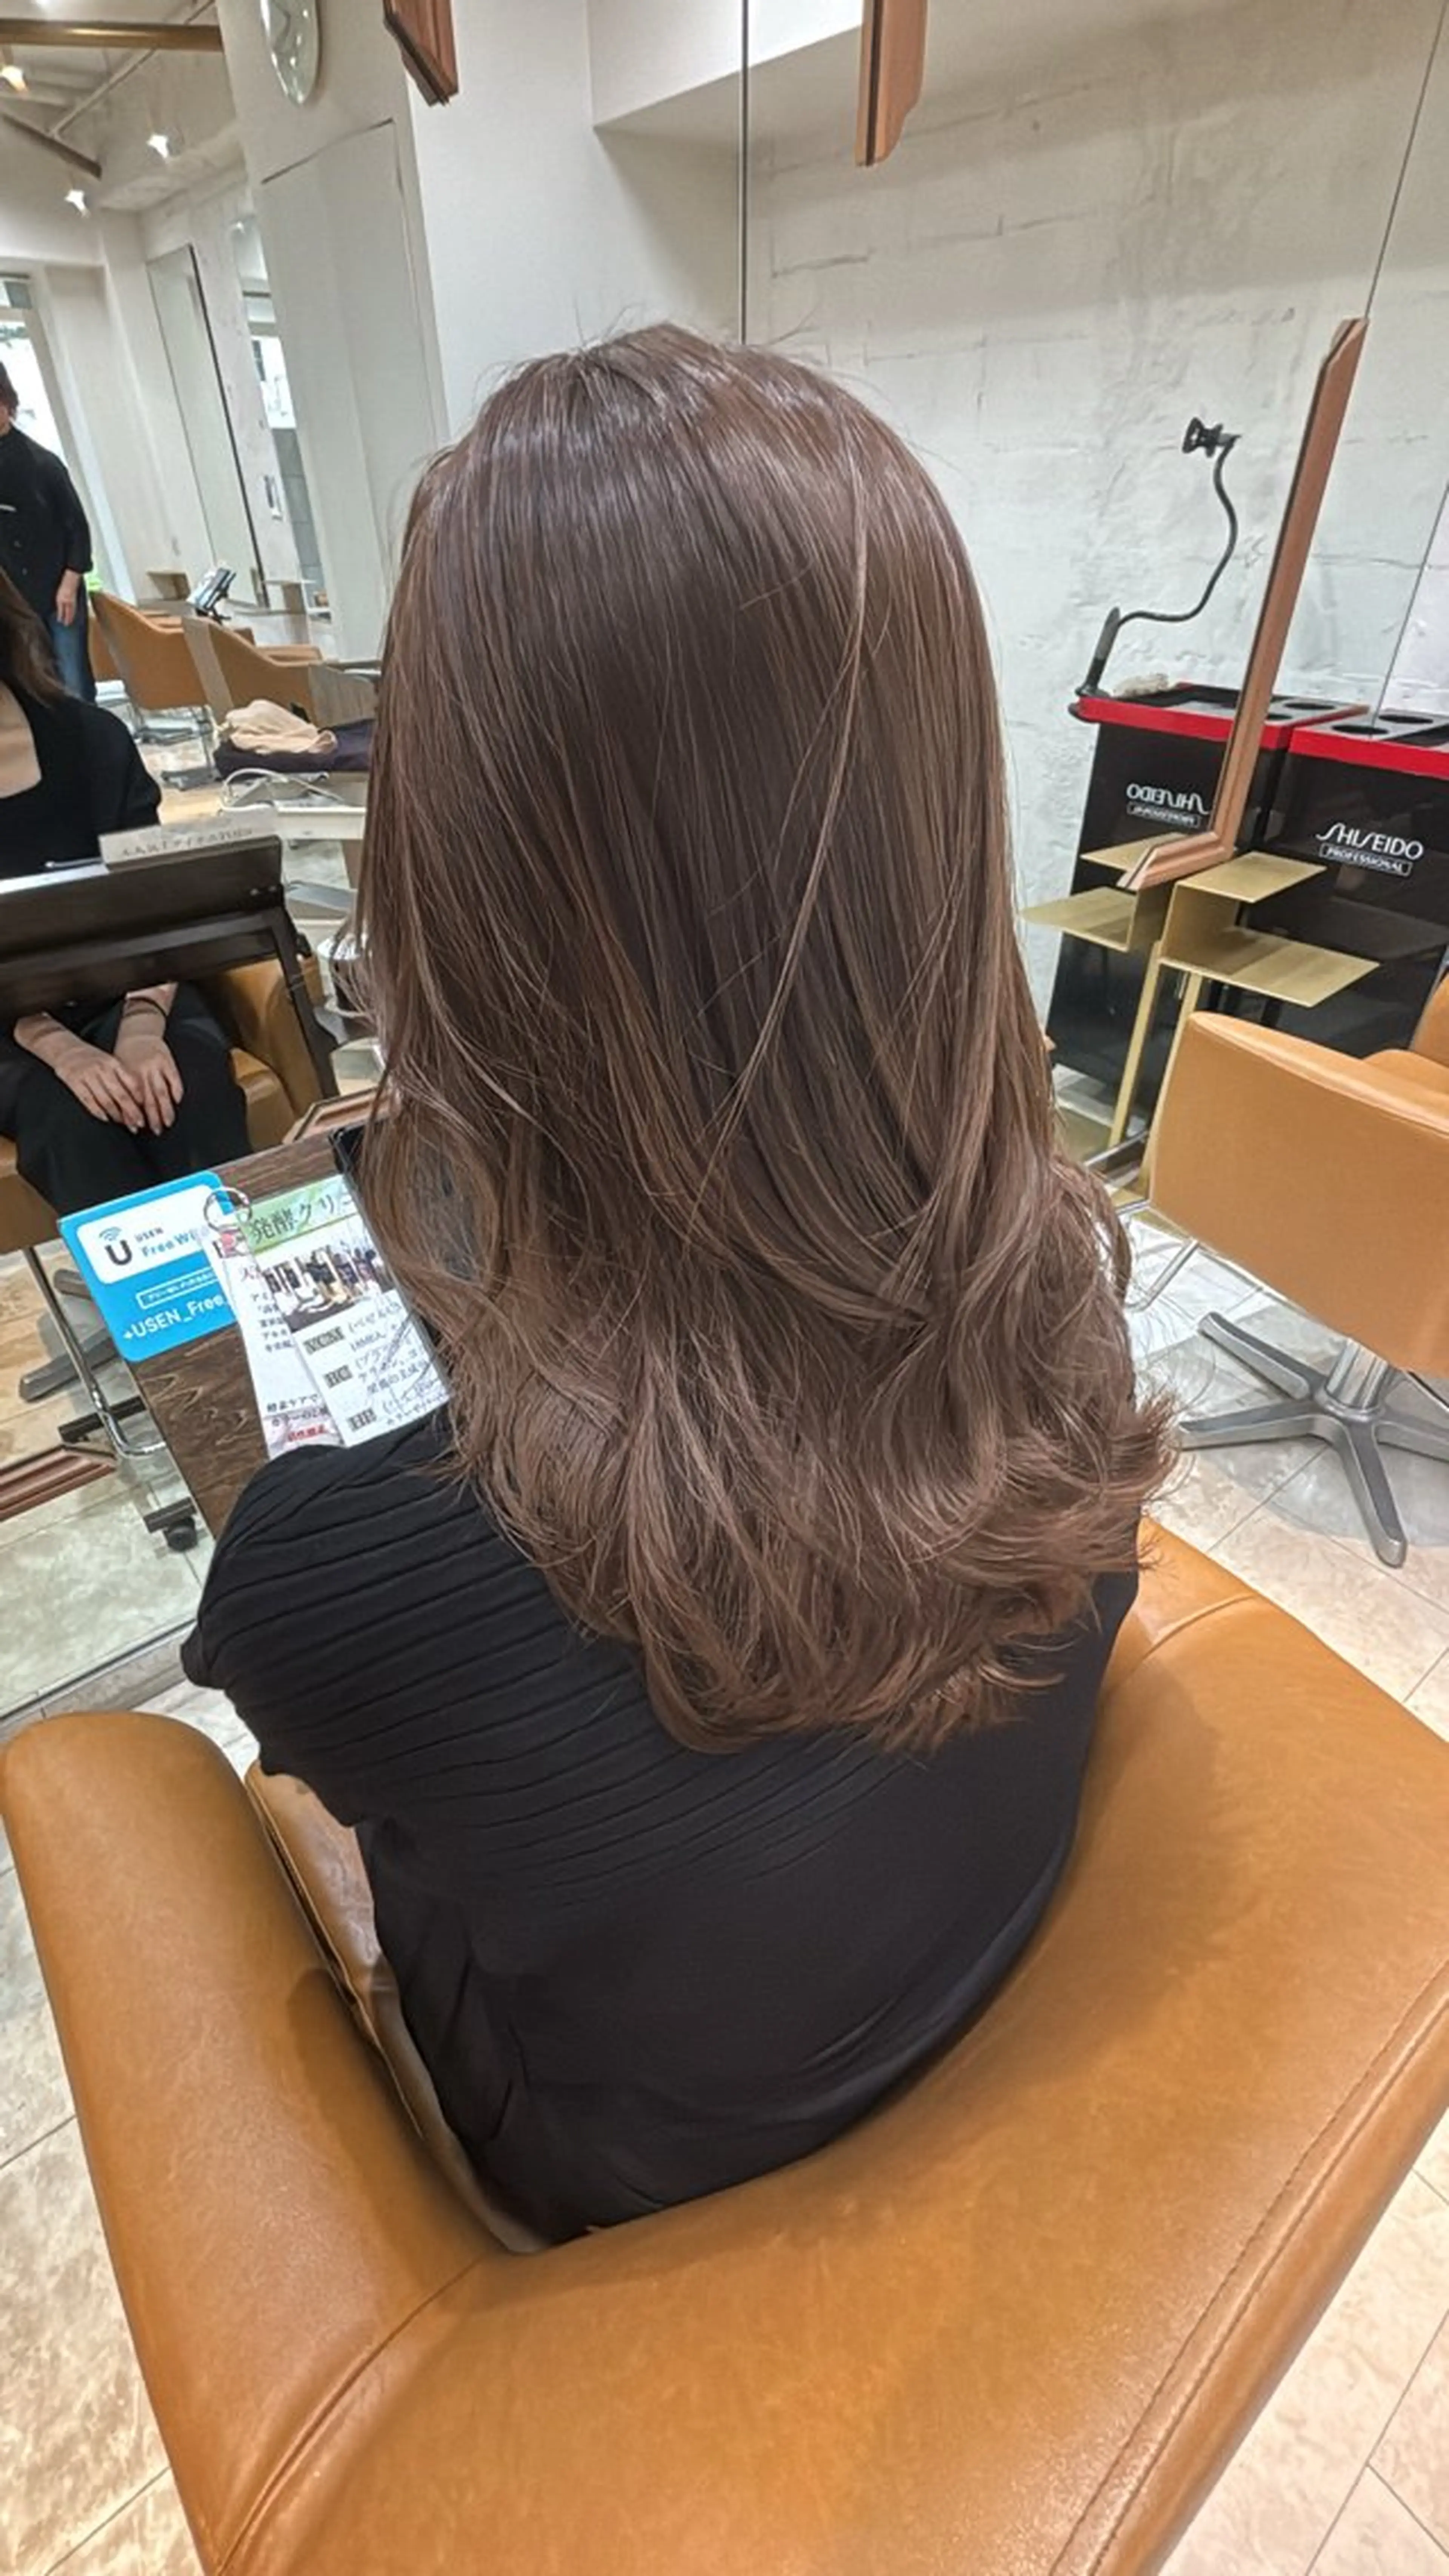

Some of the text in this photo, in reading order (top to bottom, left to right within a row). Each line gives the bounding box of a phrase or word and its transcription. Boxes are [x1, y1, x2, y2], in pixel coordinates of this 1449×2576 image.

[1315, 822, 1424, 860] SHISEIDO
[134, 1227, 163, 1242] USEN
[141, 1240, 175, 1257] Free
